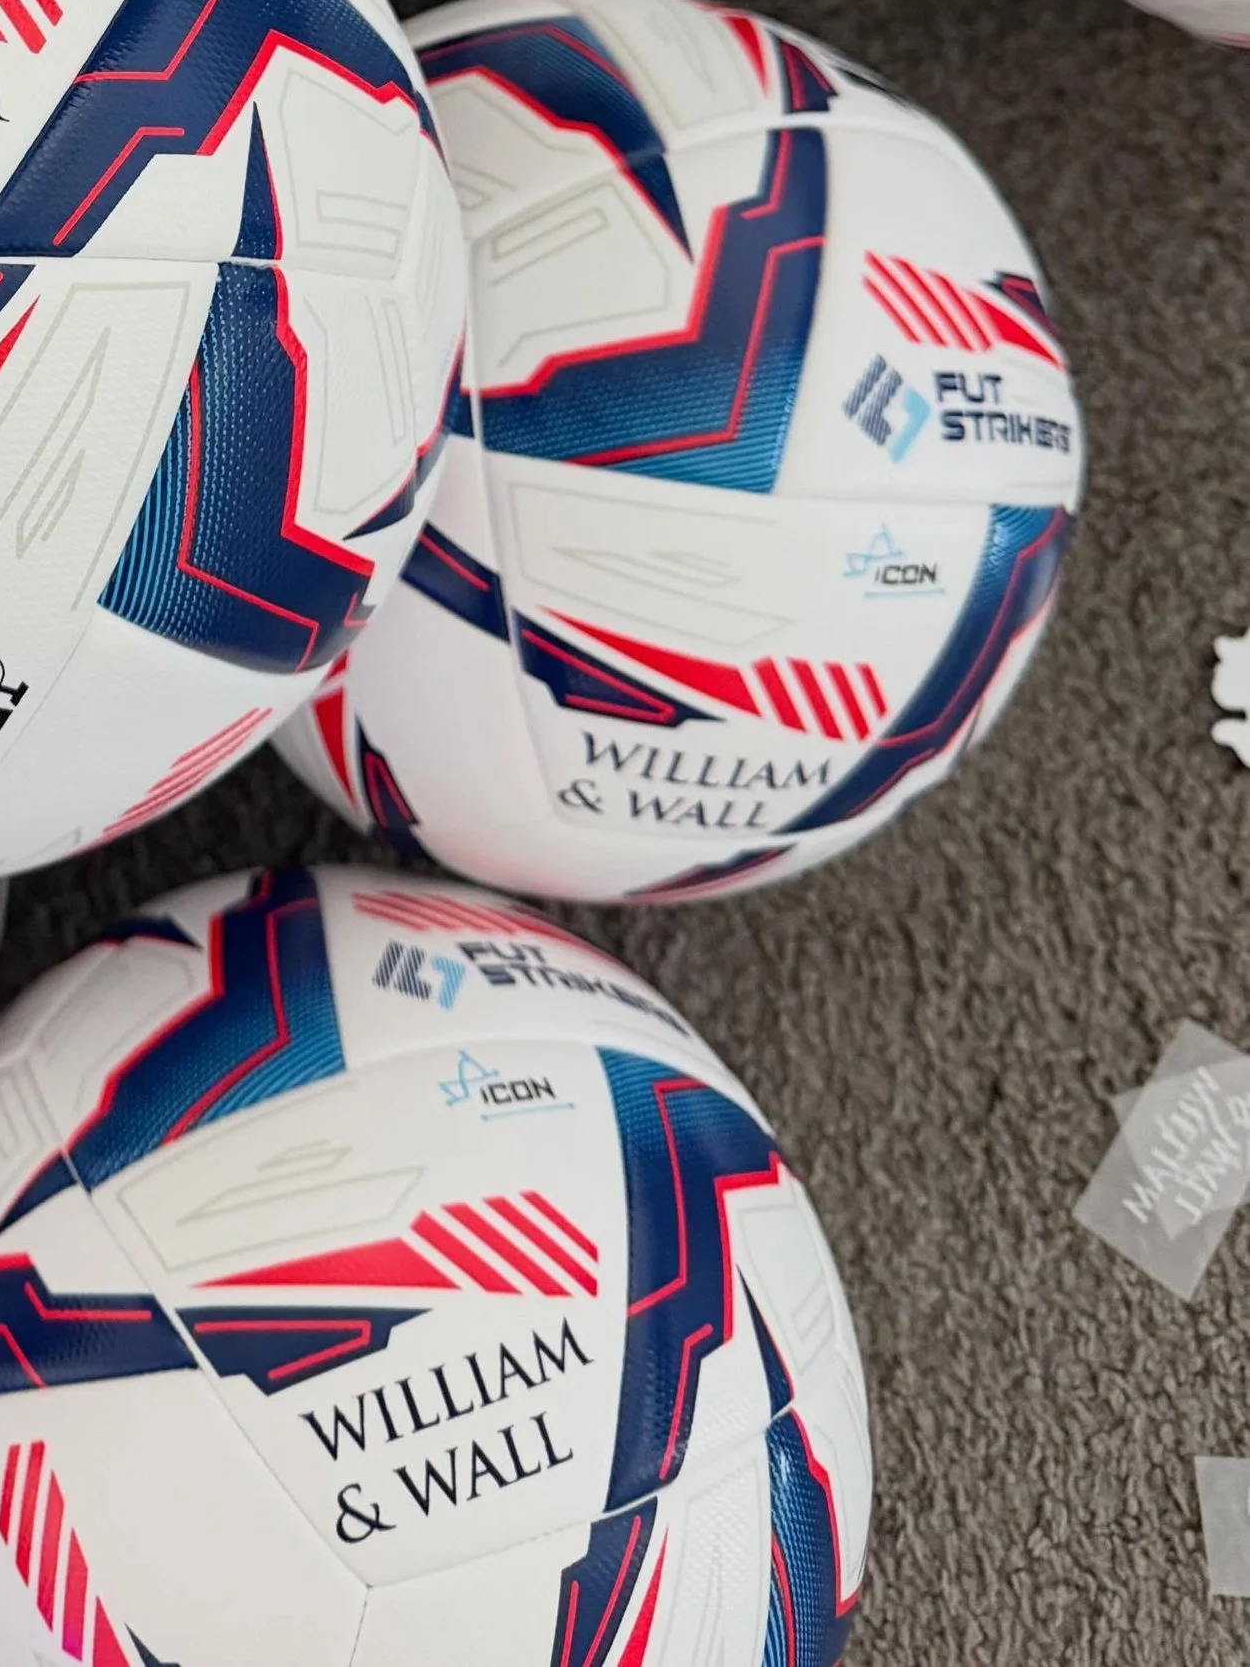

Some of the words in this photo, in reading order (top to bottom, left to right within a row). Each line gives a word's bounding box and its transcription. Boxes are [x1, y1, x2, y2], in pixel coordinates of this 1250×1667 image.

[933, 370, 1003, 405] FUT
[940, 409, 1071, 456] STRIKERS
[581, 728, 832, 790] WILLIAM
[556, 778, 603, 815] &
[626, 787, 768, 829] WALL
[455, 940, 546, 965] FUT
[298, 1316, 595, 1461] WILLIAM
[334, 1480, 397, 1544] &
[393, 1410, 574, 1517] WALL
